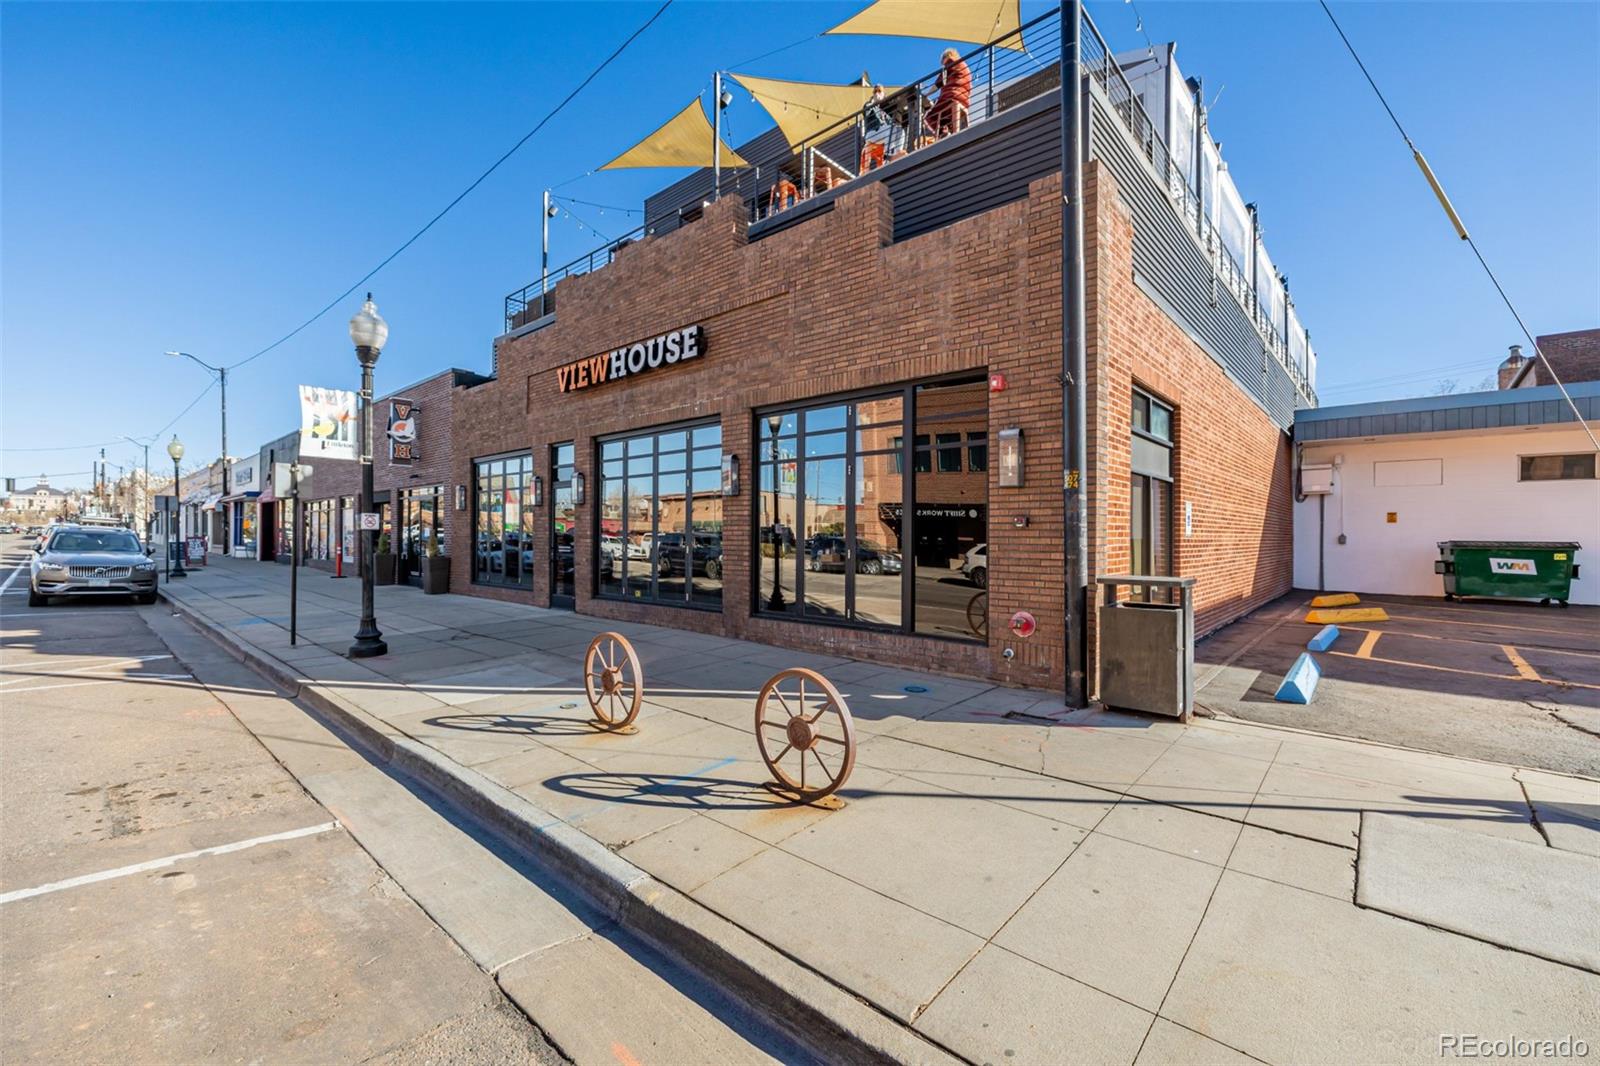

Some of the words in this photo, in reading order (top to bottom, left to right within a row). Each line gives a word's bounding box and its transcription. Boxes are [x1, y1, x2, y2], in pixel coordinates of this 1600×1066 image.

[556, 325, 698, 393] VIEWHOUSE
[395, 404, 411, 420] V
[394, 443, 411, 459] H
[1497, 562, 1530, 571] WM
